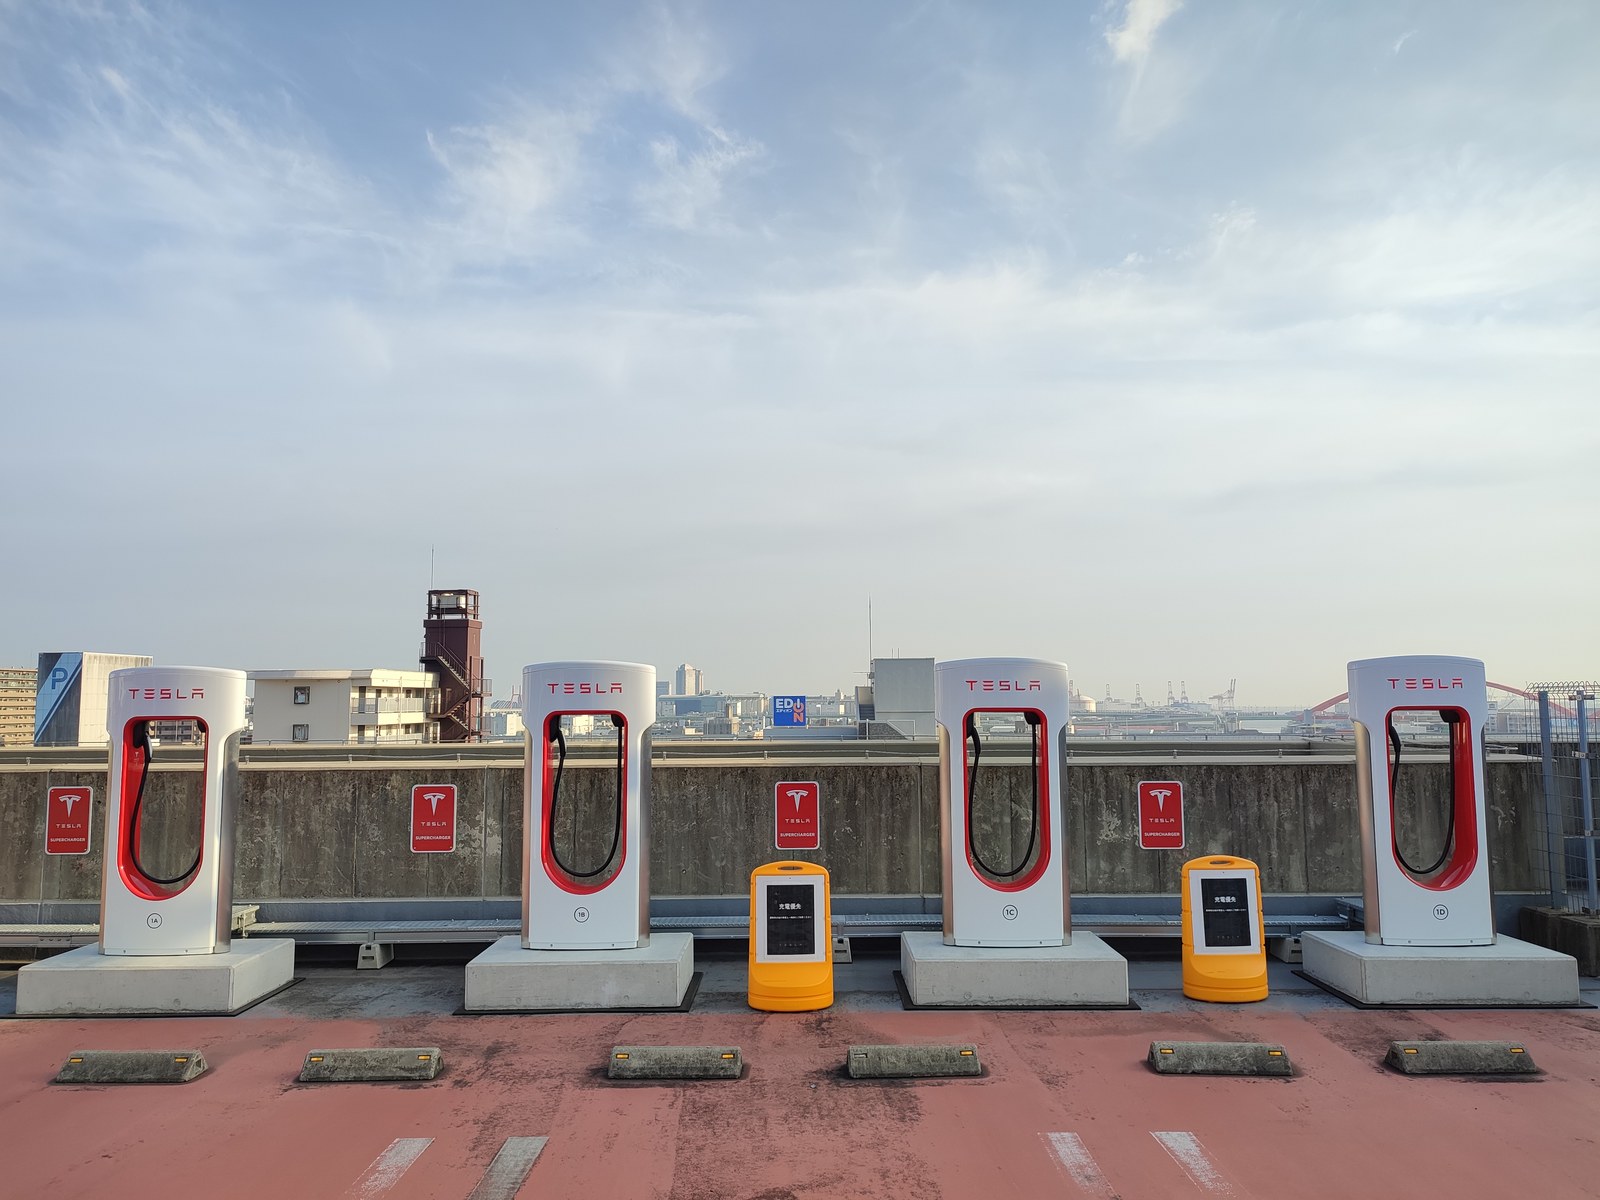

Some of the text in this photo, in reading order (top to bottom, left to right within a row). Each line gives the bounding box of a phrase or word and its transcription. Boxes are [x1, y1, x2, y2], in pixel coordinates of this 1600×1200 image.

[51, 668, 68, 689] P
[1387, 678, 1463, 689] TESLA
[547, 682, 622, 694] TESLA
[965, 680, 1041, 691] TESLA
[129, 688, 204, 699] TESLA
[1436, 908, 1446, 916] 1D
